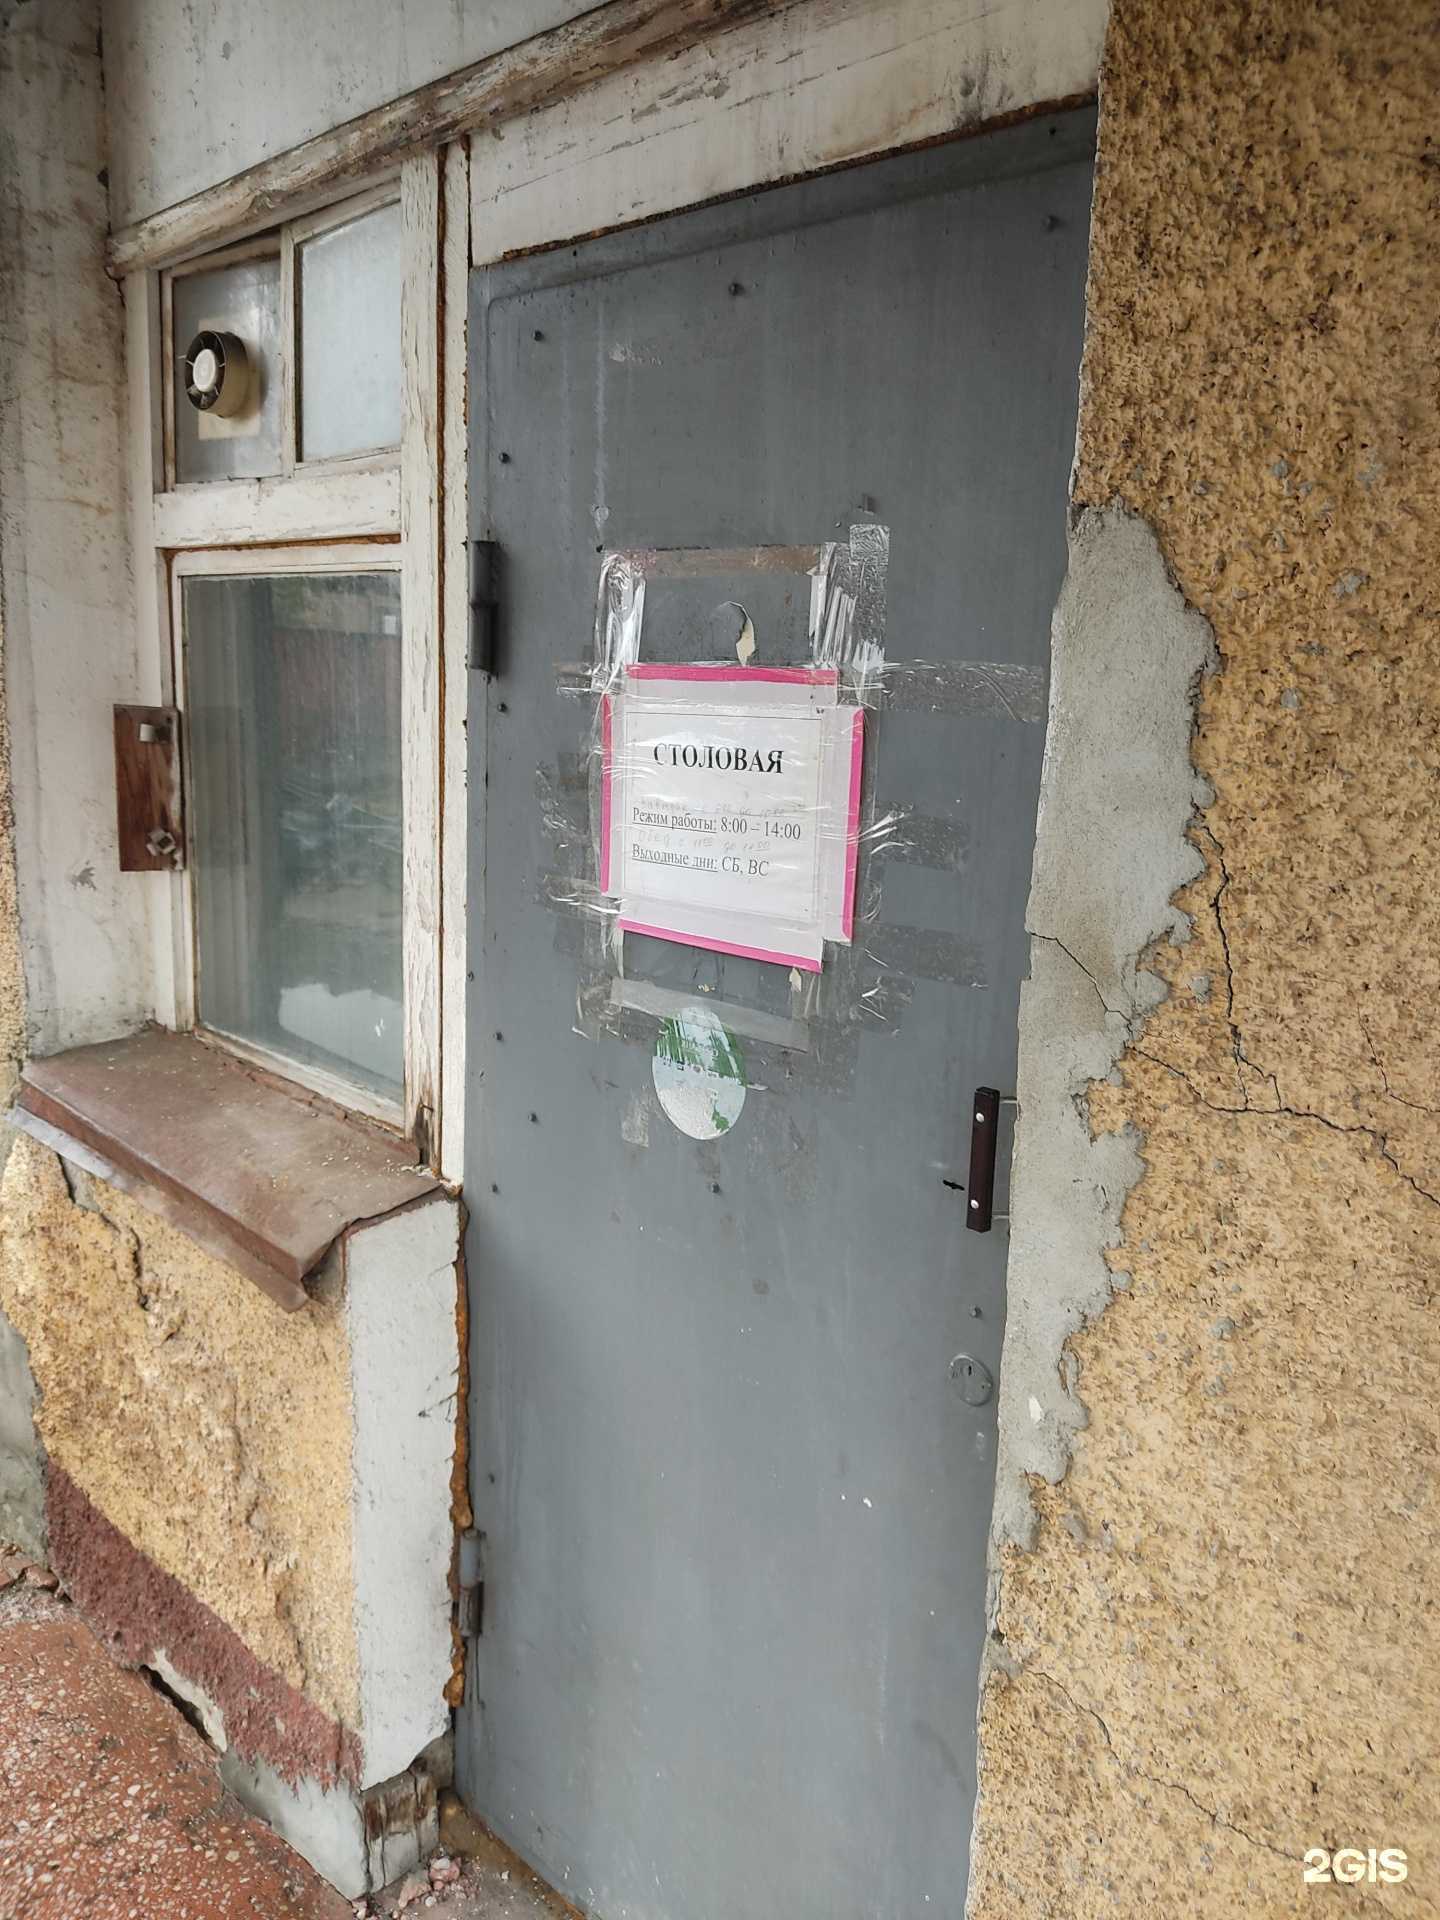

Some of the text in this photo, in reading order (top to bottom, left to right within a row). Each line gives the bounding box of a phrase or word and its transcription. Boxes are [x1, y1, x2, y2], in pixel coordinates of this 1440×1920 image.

[653, 743, 784, 773] СТОЛОВАЯ
[633, 807, 668, 825] Режим
[671, 812, 717, 832] работы:
[720, 816, 747, 834] 8:00
[764, 820, 801, 840] 14:00
[632, 843, 770, 876] Выходные дни: СБ, ВС
